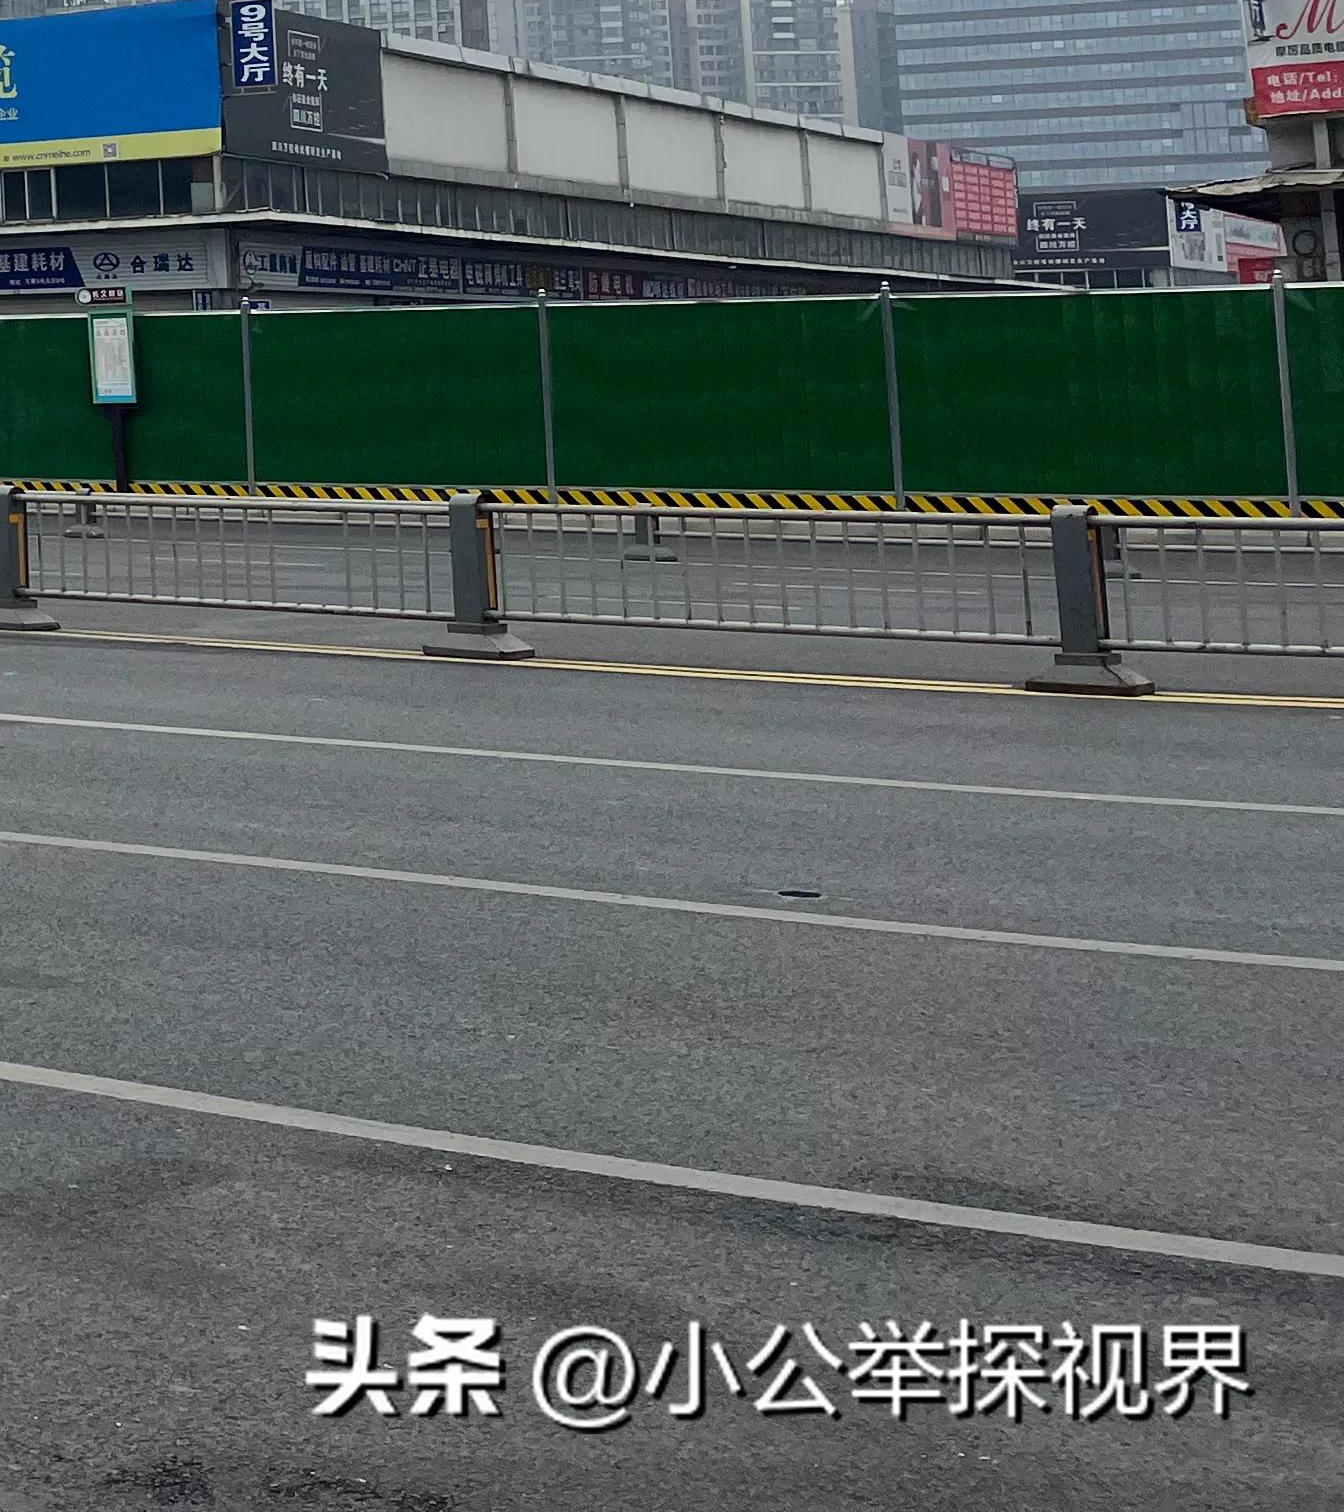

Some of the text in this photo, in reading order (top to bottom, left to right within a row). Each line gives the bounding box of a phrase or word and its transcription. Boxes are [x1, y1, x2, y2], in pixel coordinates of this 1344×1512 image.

[238, 4, 271, 83] 9号大厅
[282, 61, 329, 92] 终有一天
[130, 252, 194, 274] 合瑞达
